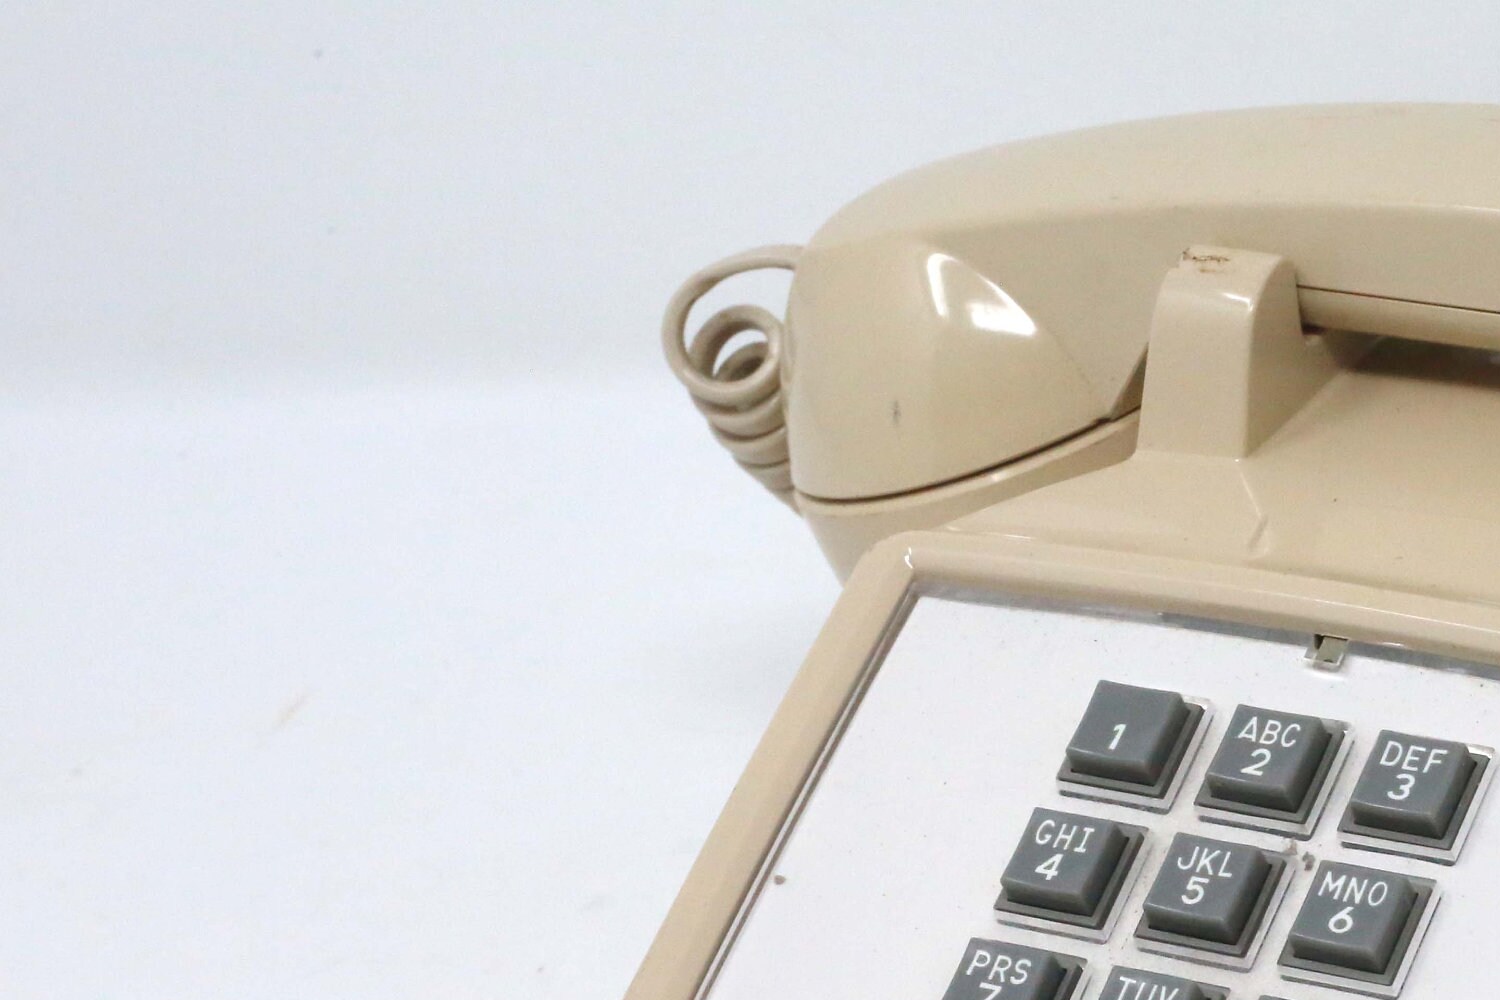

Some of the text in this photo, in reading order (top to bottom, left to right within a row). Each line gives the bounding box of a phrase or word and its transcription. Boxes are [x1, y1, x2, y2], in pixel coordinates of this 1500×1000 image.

[1110, 723, 1126, 750] 1
[1238, 716, 1301, 747] ABC
[1241, 748, 1270, 776] 2
[1379, 741, 1448, 772] DEF
[1387, 774, 1413, 800] 3
[1035, 819, 1095, 854] GHI
[1034, 854, 1060, 880] 4
[1177, 846, 1233, 878] JKL
[1181, 877, 1210, 905] 5
[1317, 871, 1388, 906] MNO
[1328, 907, 1354, 933] 6
[966, 951, 1031, 984] PRS
